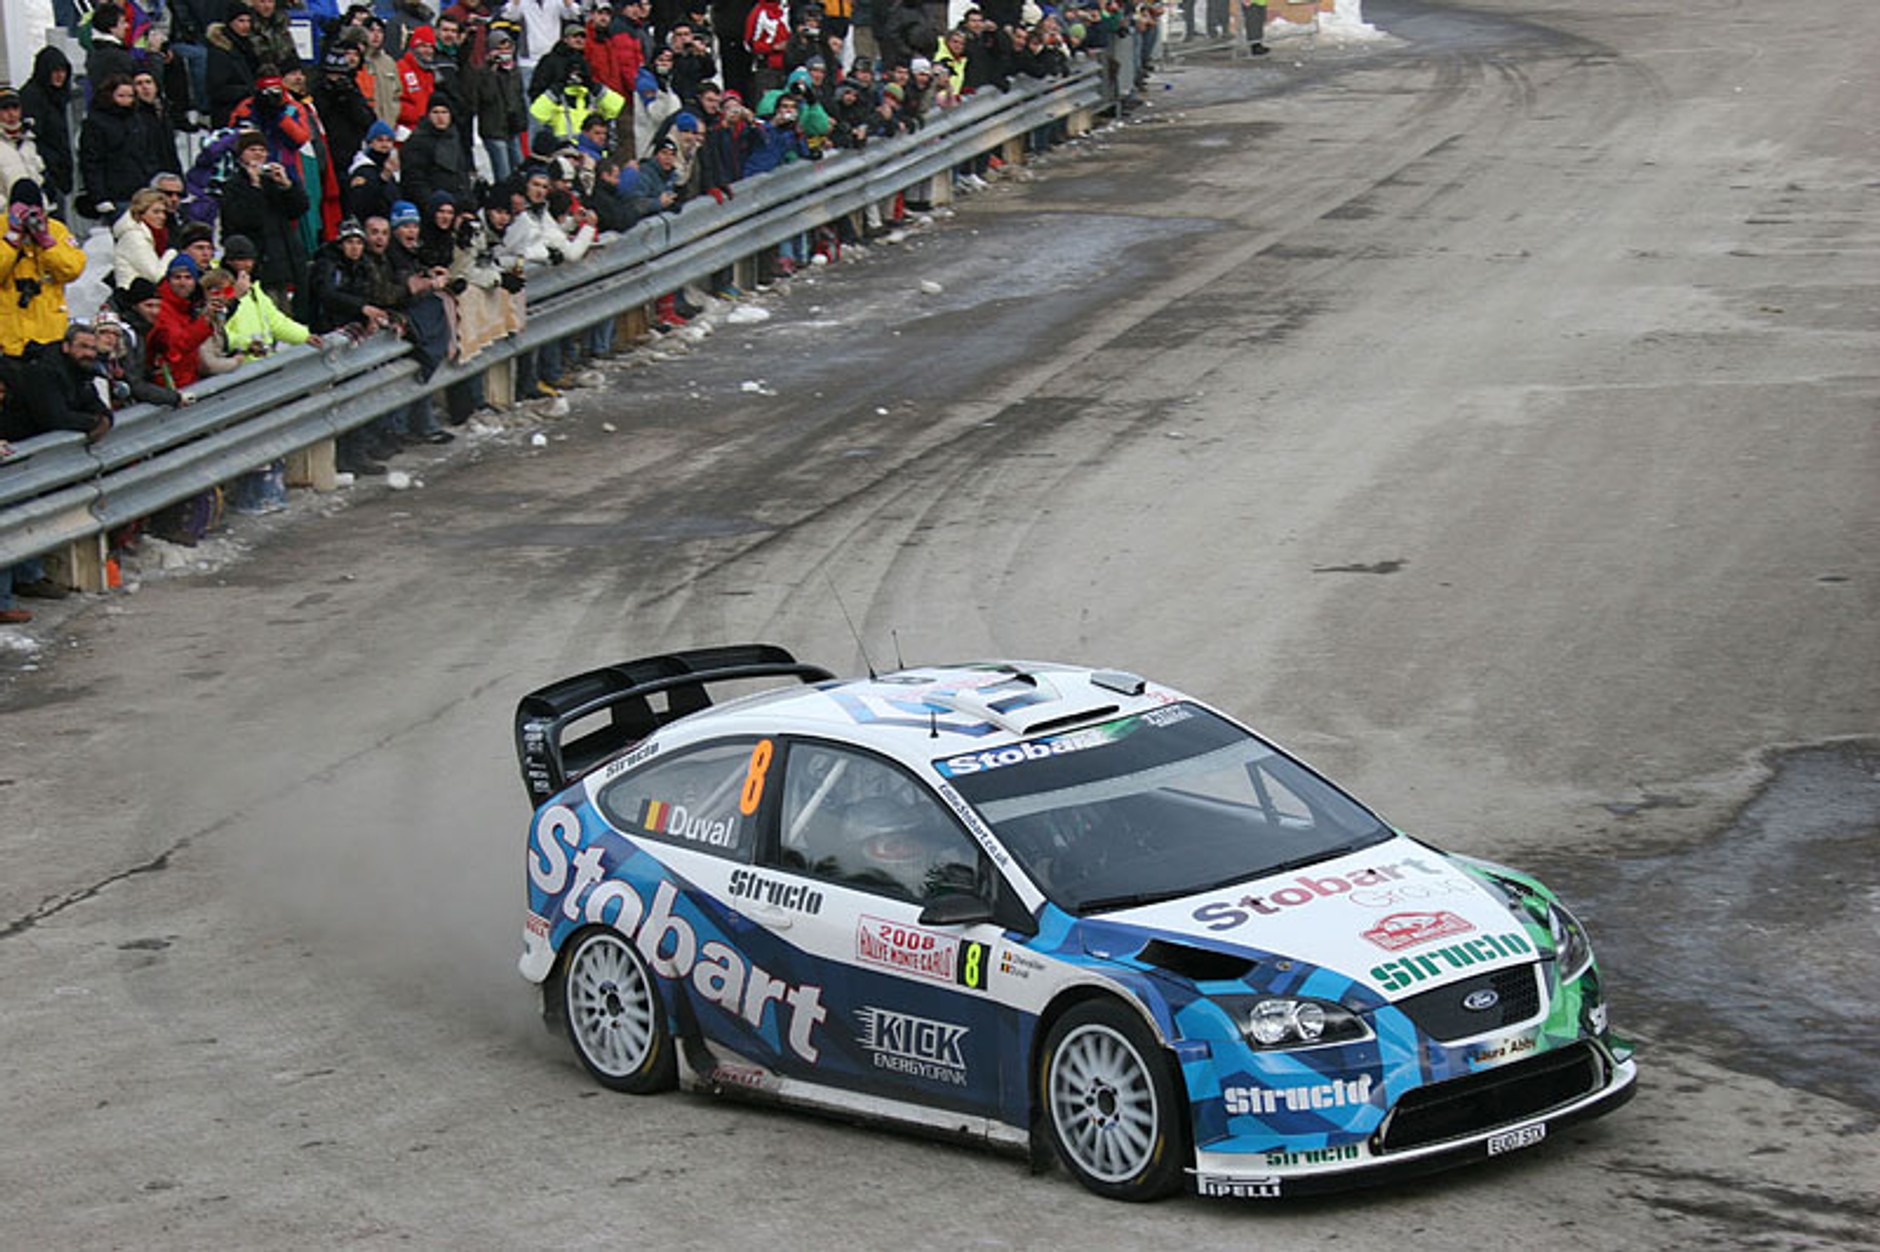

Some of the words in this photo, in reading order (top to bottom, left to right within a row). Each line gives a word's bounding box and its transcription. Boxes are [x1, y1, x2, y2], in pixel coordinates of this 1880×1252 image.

[739, 739, 774, 816] 8
[667, 806, 735, 848] Duval
[728, 869, 824, 915] Structo
[1191, 856, 1443, 932] Stobart
[528, 805, 827, 1064] Stobart
[878, 925, 936, 950] 2008
[965, 942, 982, 988] 8
[1370, 931, 1531, 992] Structo
[1224, 1077, 1371, 1114] Structo
